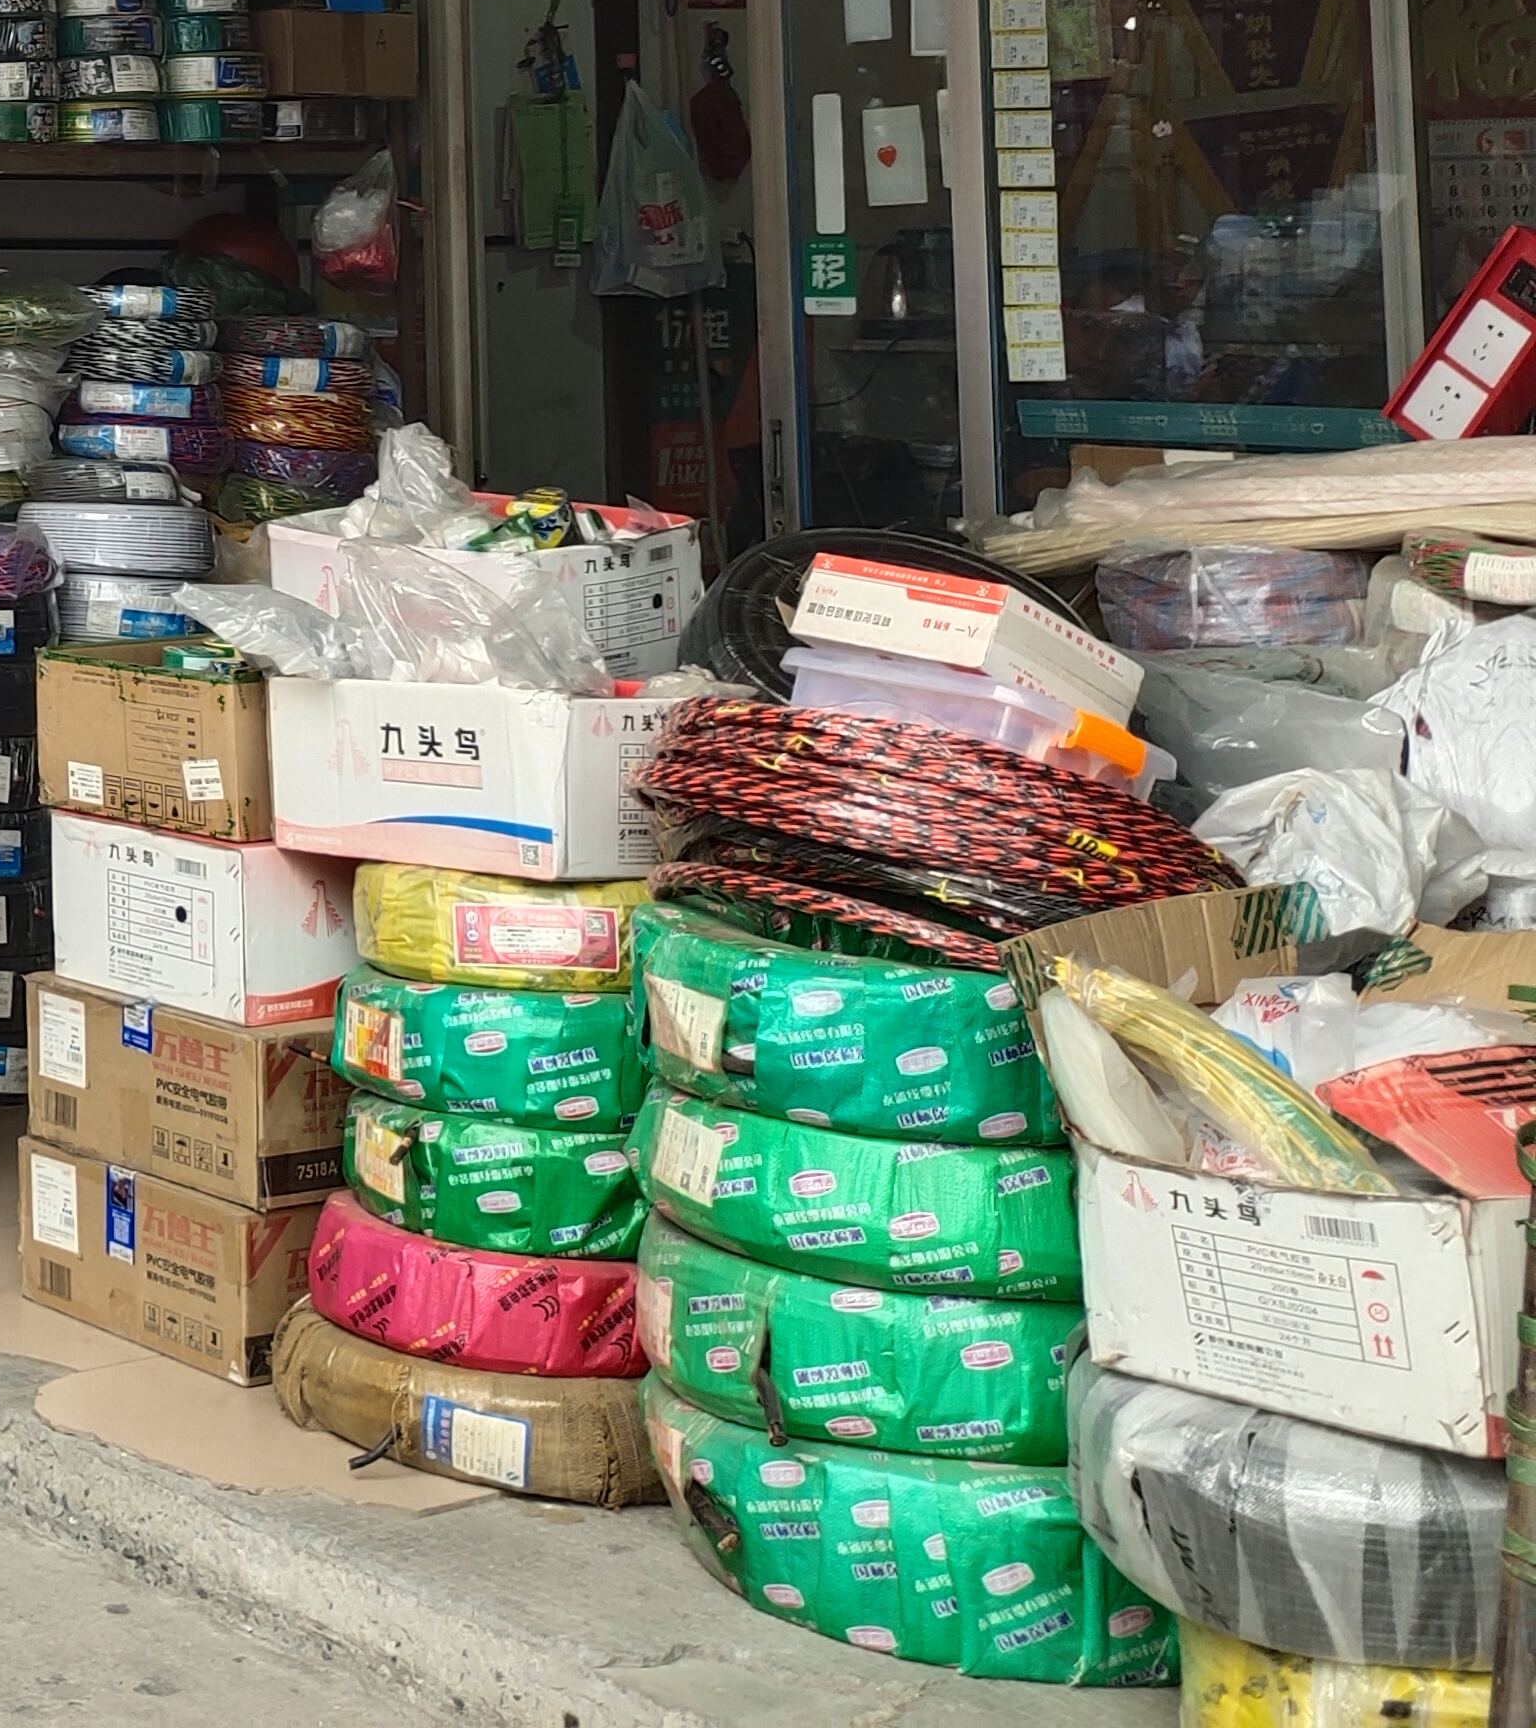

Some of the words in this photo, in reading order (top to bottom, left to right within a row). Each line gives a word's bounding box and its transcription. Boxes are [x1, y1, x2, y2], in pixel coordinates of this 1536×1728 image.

[380, 722, 481, 761] 九头鸟
[107, 843, 156, 868] 九头鸟
[1169, 1188, 1263, 1227] 九头鸟
